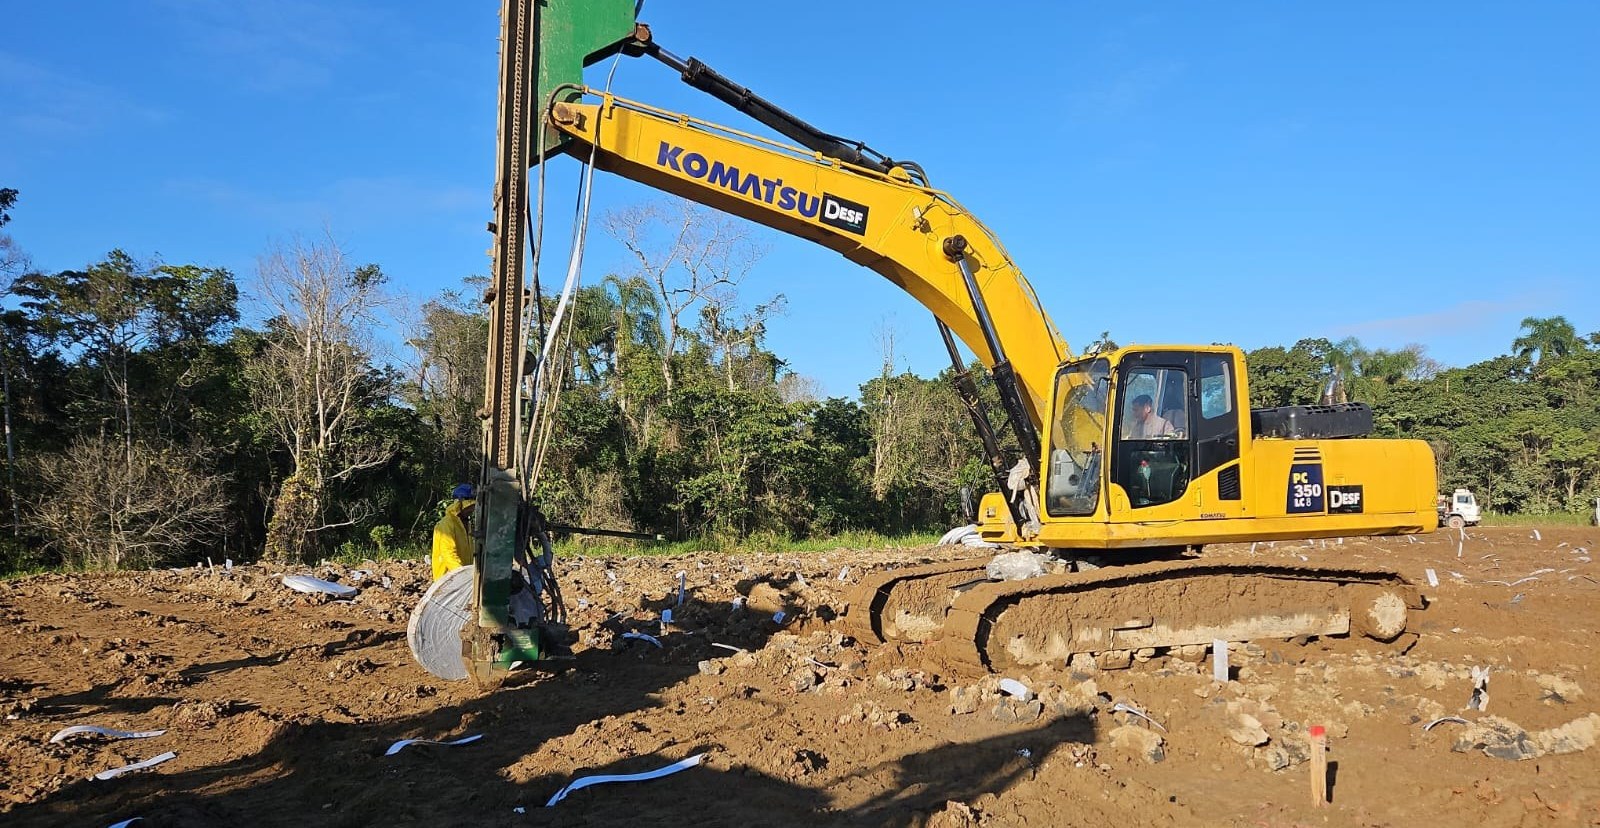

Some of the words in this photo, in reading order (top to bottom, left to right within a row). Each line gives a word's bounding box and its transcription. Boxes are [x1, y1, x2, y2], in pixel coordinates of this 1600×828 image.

[657, 141, 819, 218] KOMATSU
[1293, 472, 1308, 484] PC
[1294, 484, 1321, 497] 350
